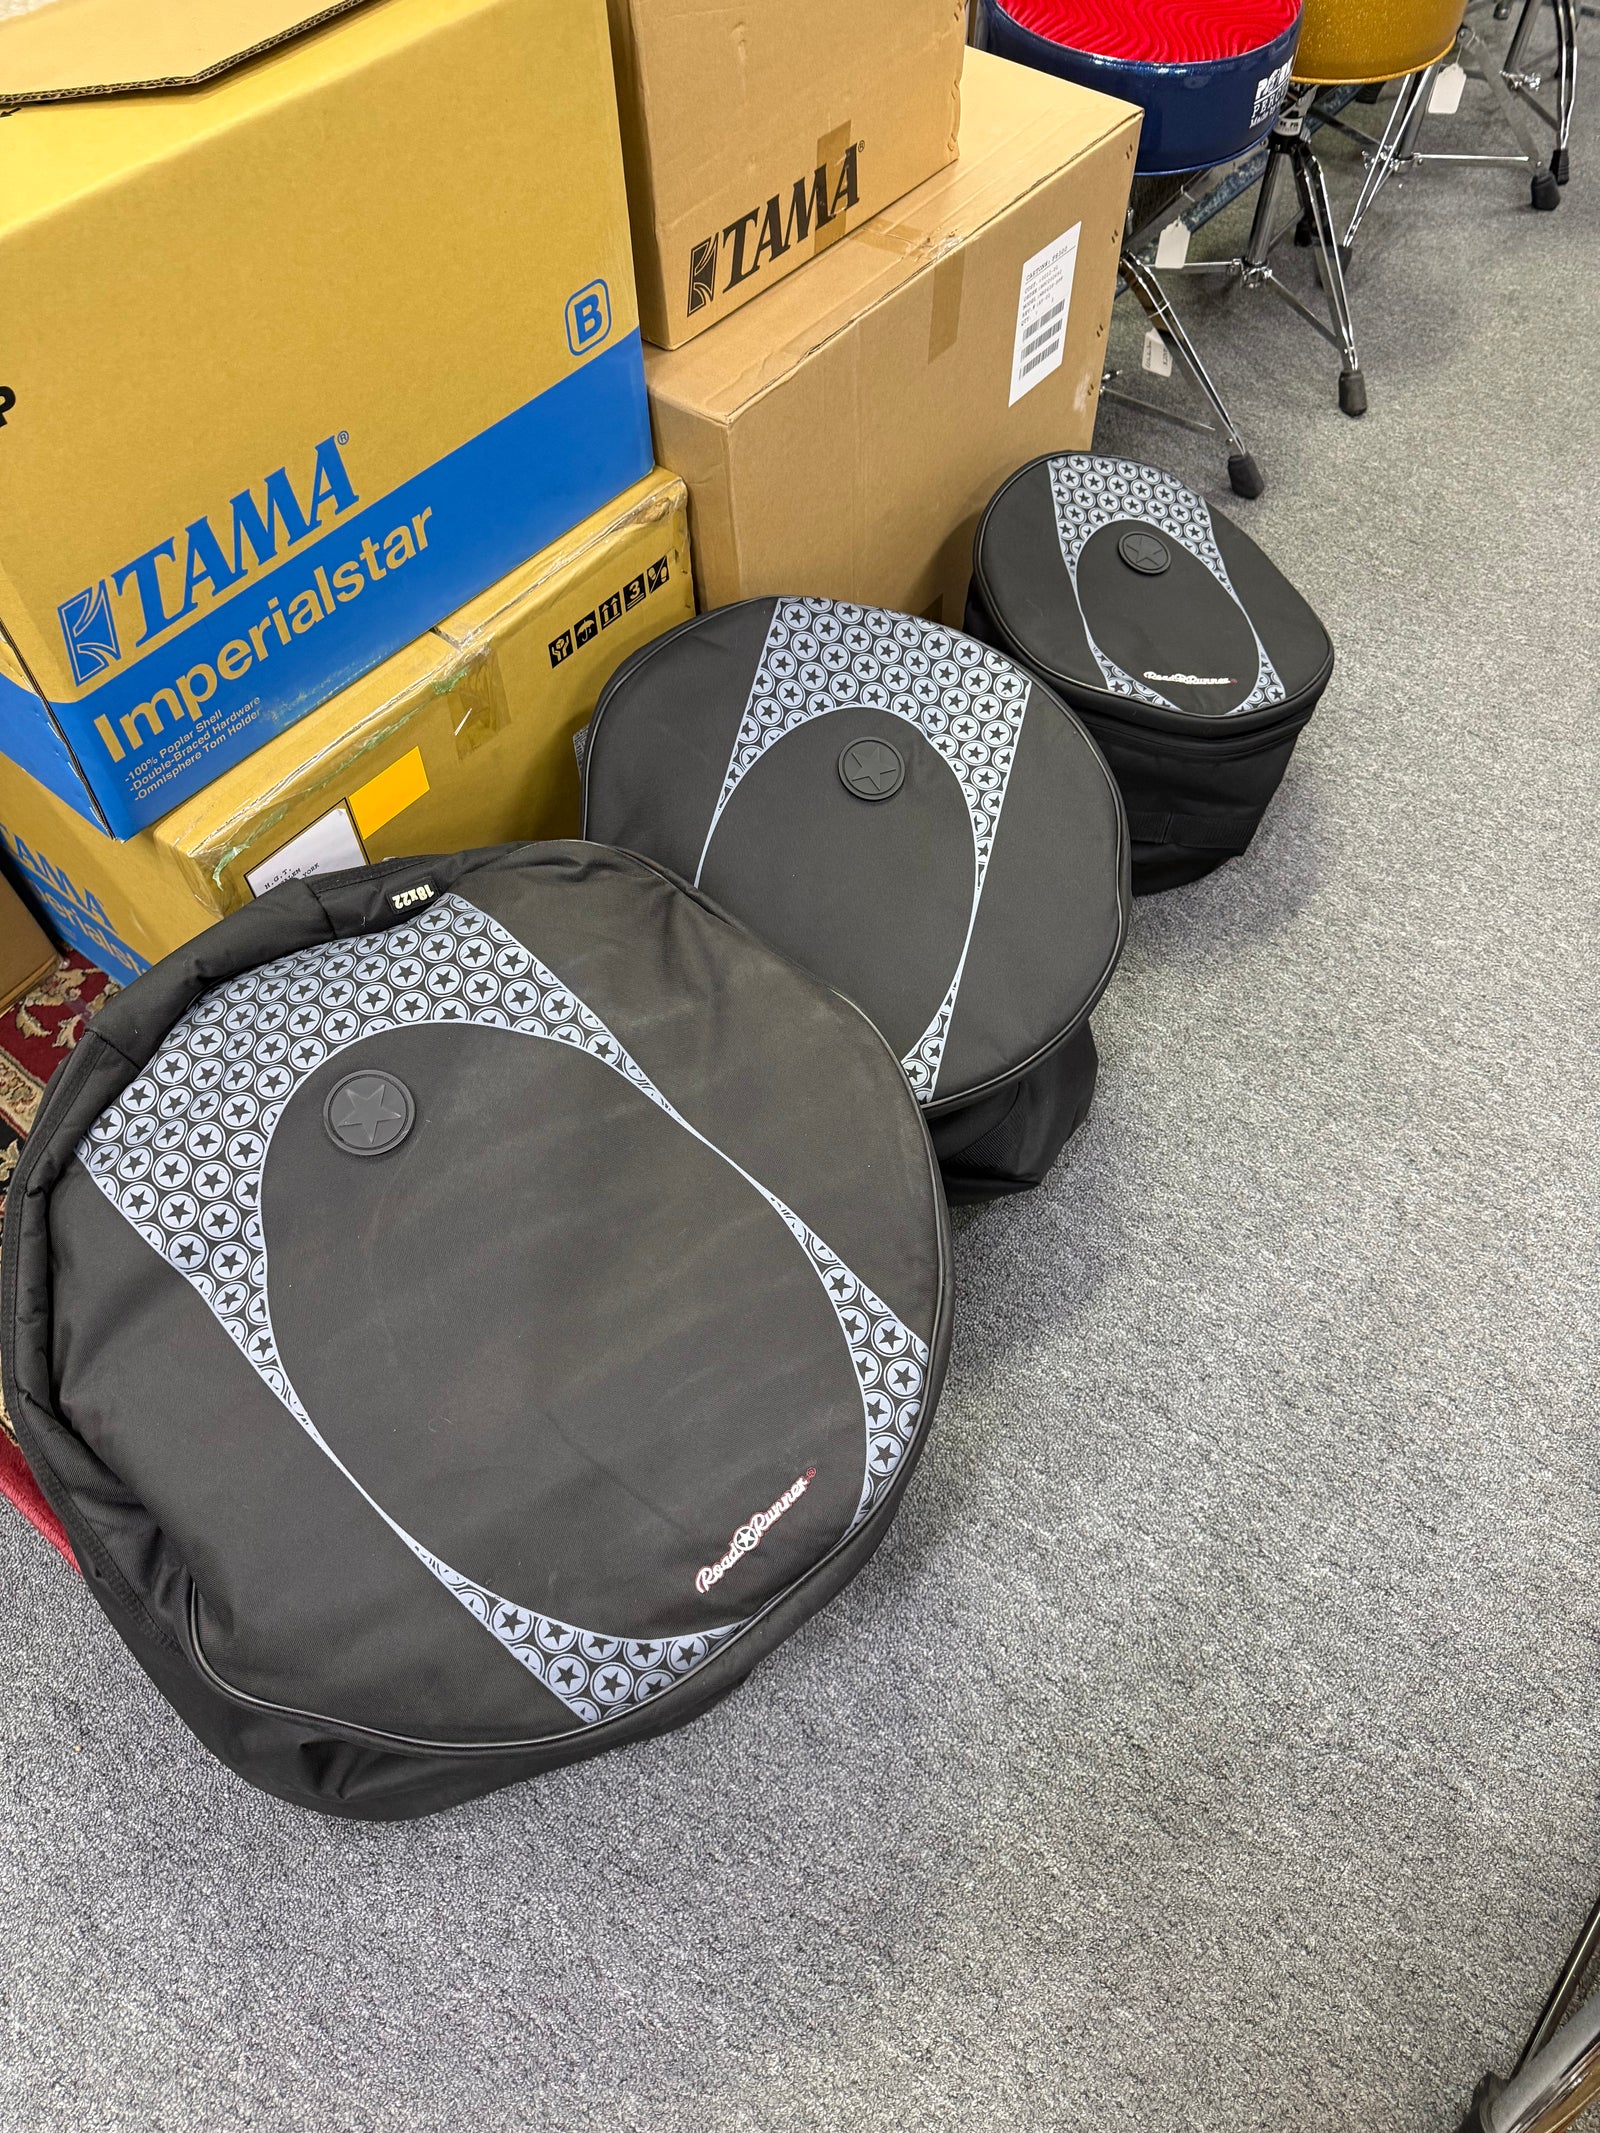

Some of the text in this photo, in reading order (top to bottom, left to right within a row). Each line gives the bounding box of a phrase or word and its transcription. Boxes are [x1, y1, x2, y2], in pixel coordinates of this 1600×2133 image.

[573, 293, 603, 345] B
[93, 506, 433, 764] Imperialstar
[1143, 671, 1175, 682] Road
[159, 730, 194, 758] Poplar
[195, 709, 222, 733] Shell
[202, 734, 226, 753] Tom
[226, 708, 260, 737] Holder
[212, 696, 260, 733] Hardware
[0, 822, 119, 935] AMA
[302, 862, 320, 878] YORK
[391, 883, 435, 909] 18x22
[695, 1476, 811, 1594] Road Runner
